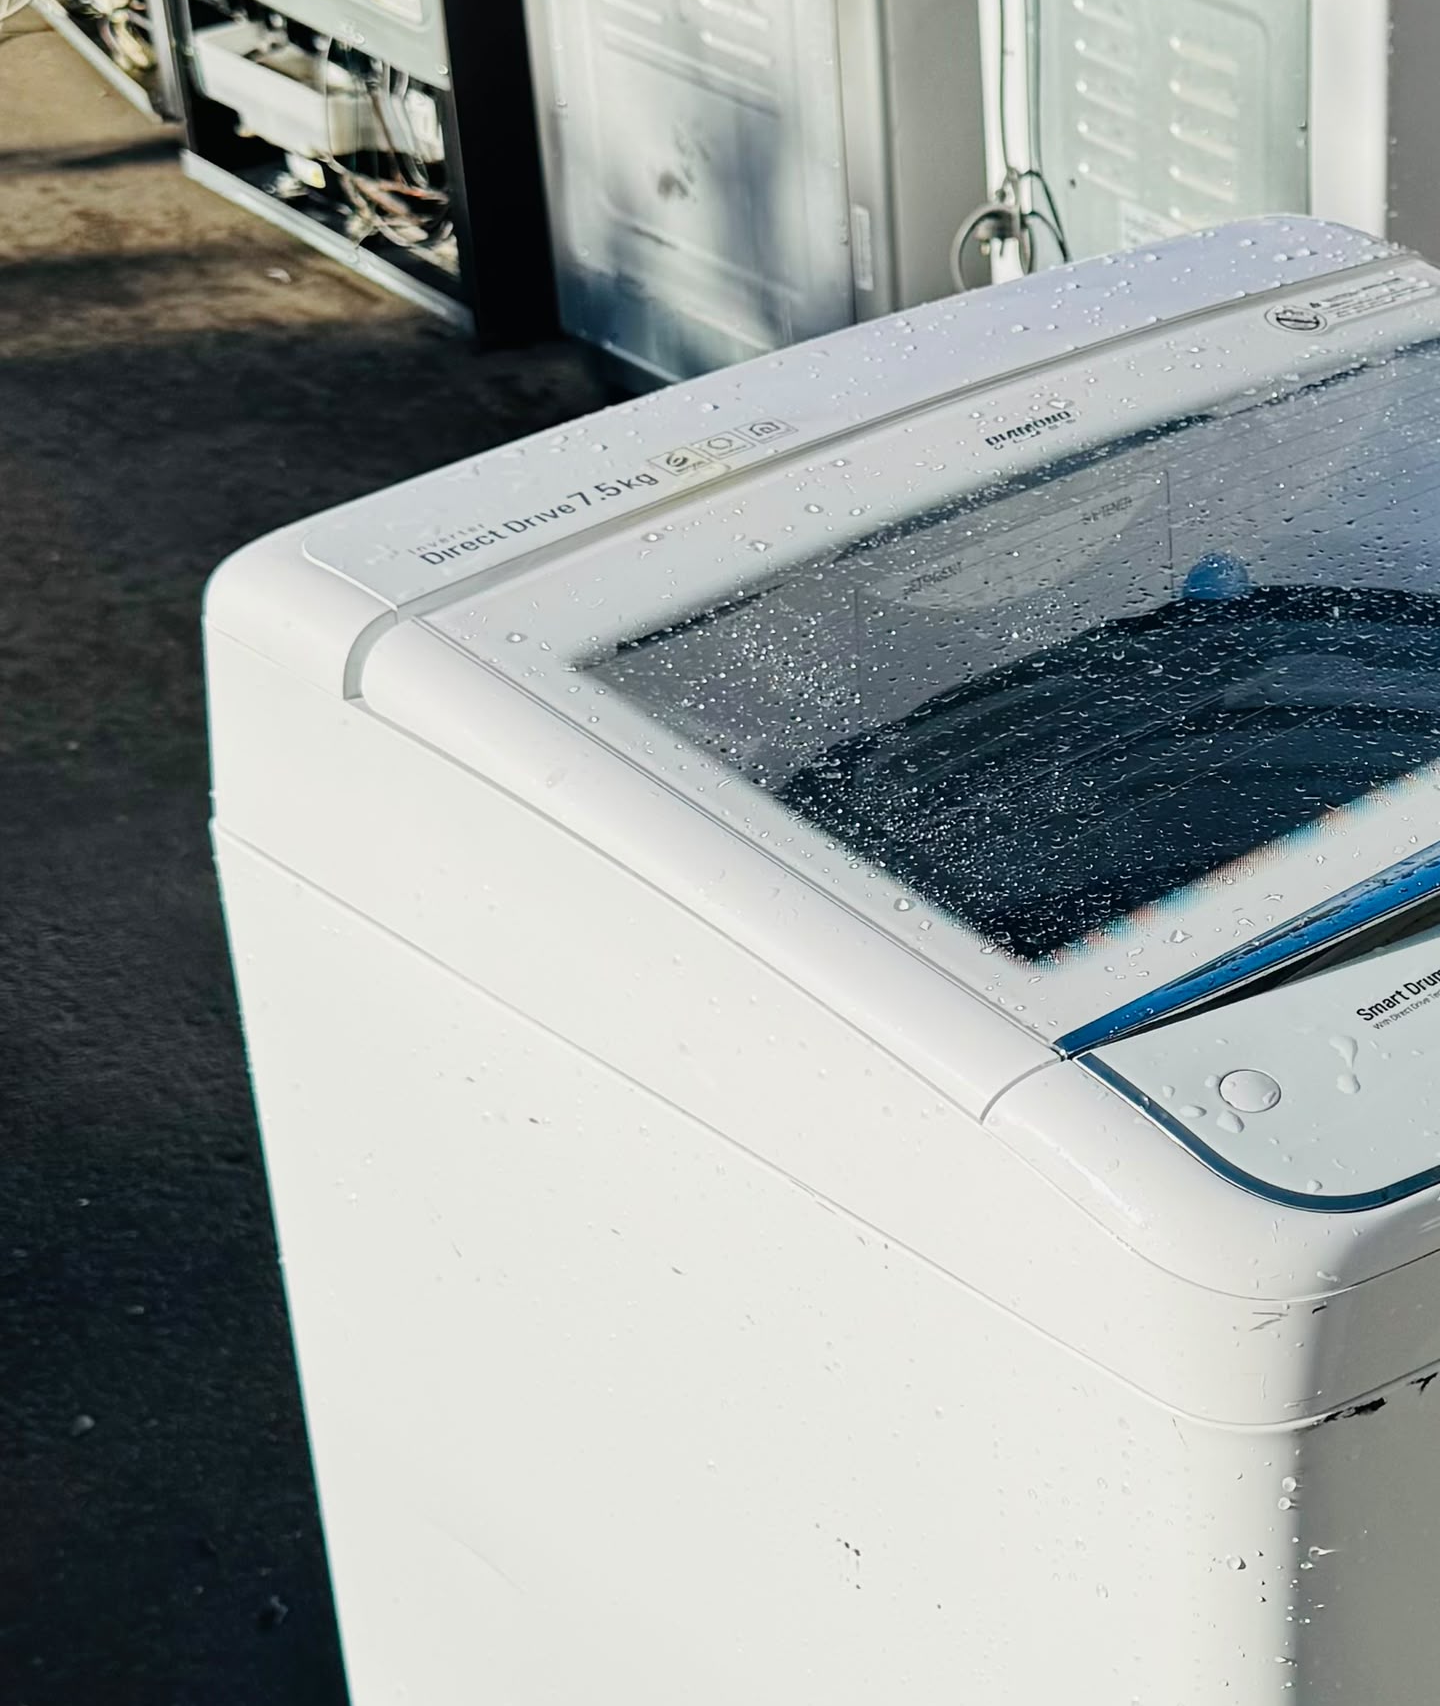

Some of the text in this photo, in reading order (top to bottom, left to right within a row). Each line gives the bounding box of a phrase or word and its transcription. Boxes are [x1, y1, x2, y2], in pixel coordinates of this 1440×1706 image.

[420, 530, 508, 565] Direct
[503, 502, 576, 534] Drive
[1356, 990, 1409, 1022] Smart
[1391, 1007, 1411, 1021] Direct
[1410, 997, 1431, 1011] Drive
